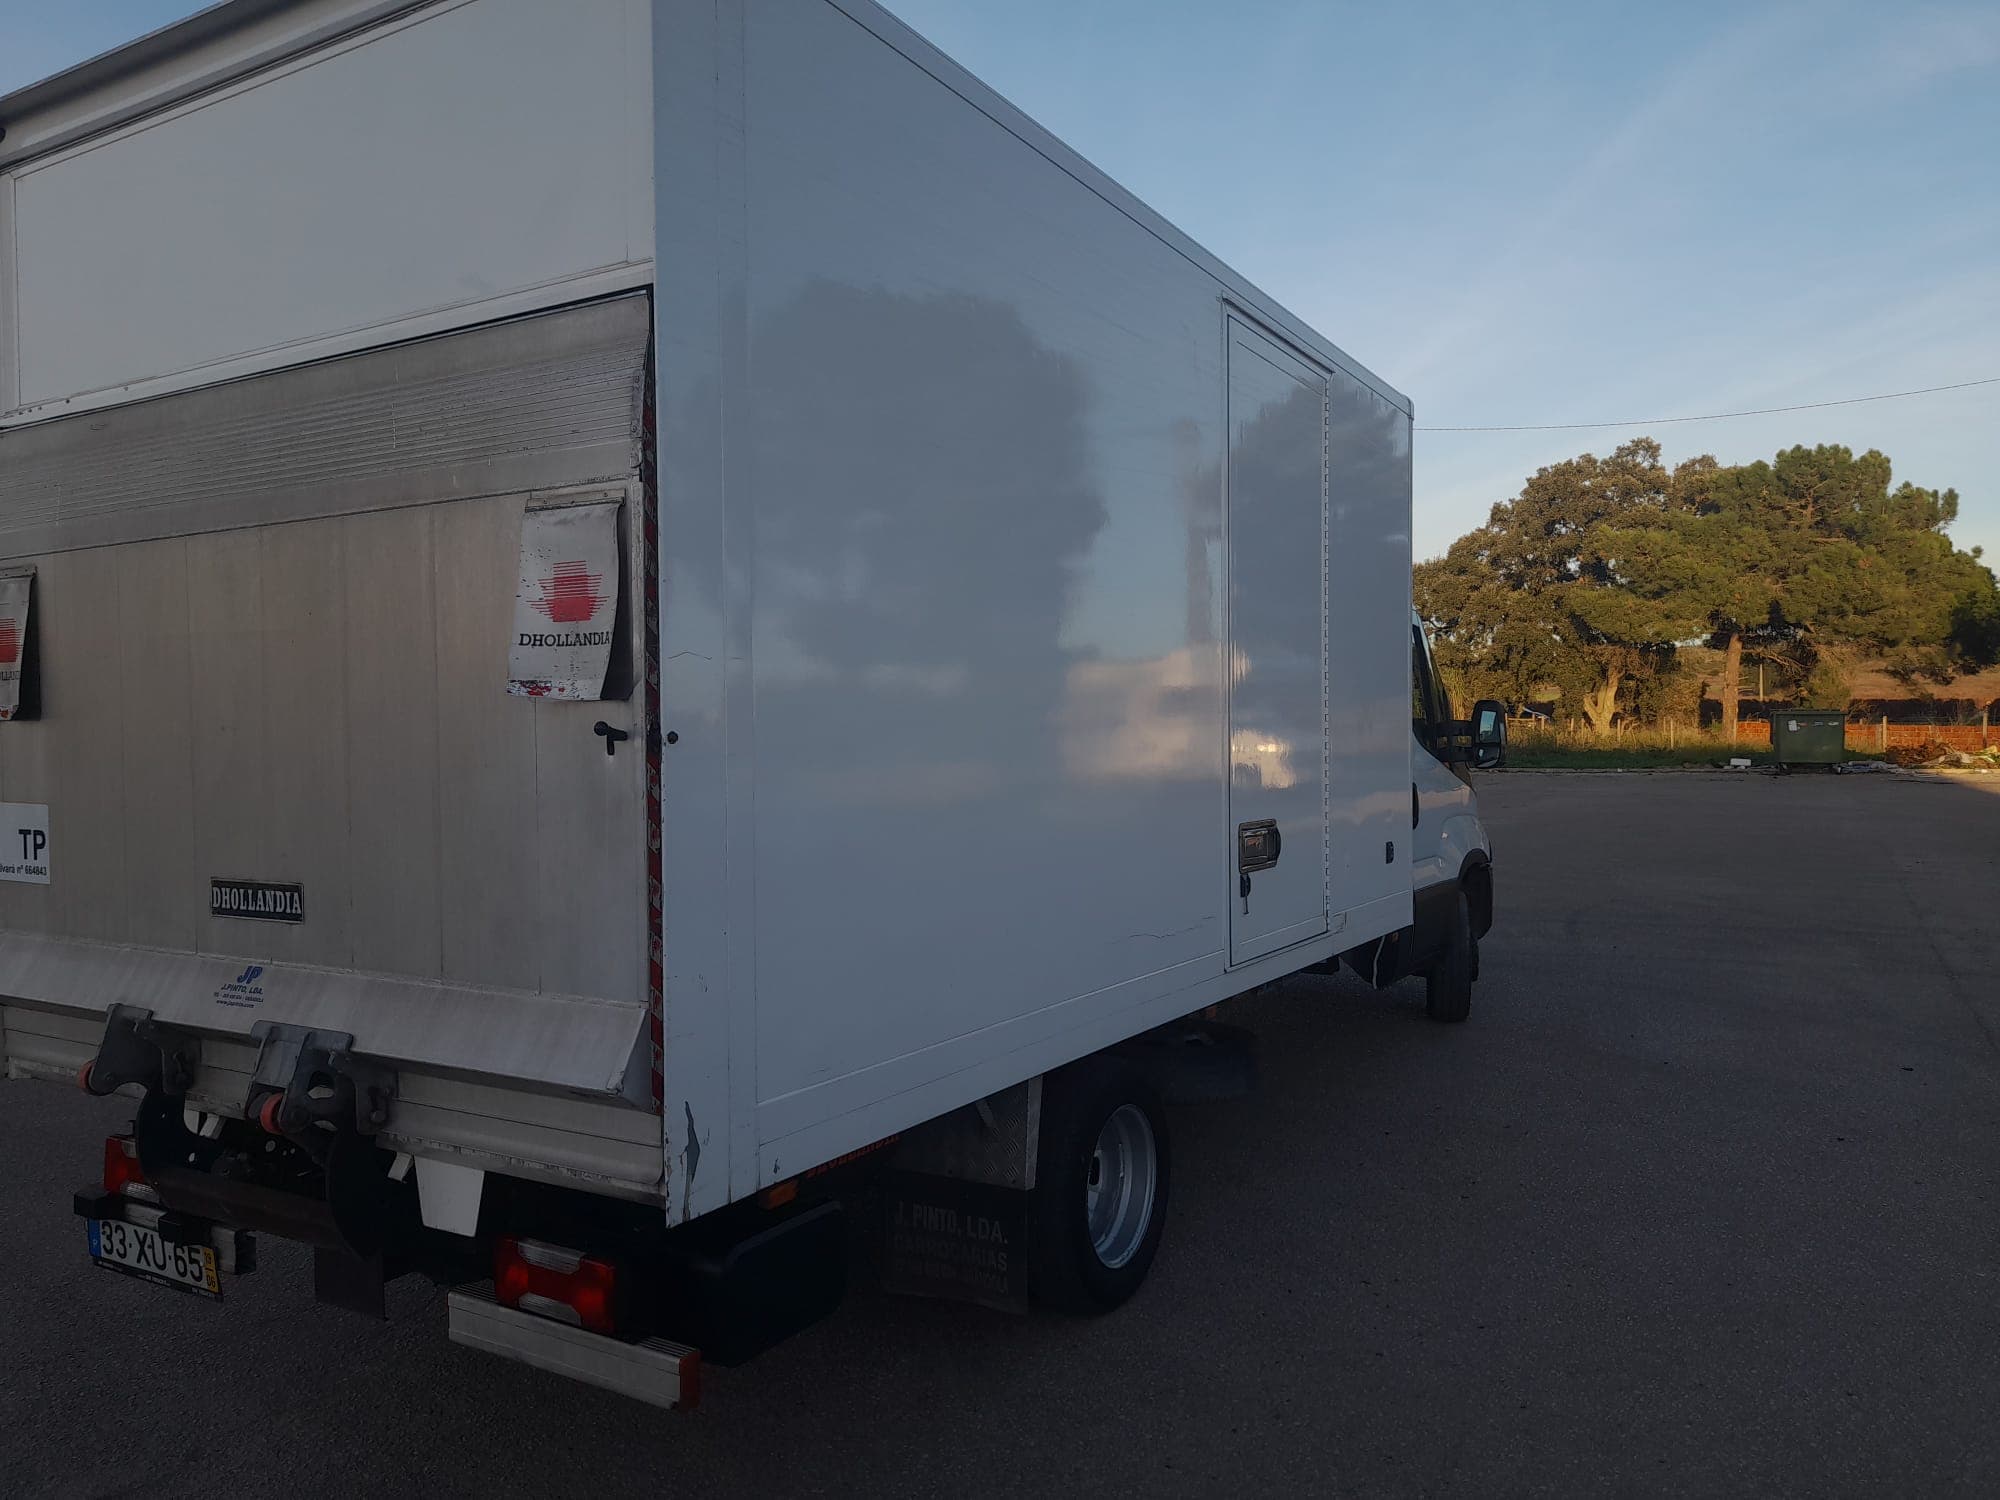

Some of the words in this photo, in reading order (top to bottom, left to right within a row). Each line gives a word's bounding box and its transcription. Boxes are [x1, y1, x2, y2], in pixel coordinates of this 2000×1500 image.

[518, 631, 610, 647] DHOLLANDIA
[18, 829, 46, 860] TP
[212, 887, 302, 915] DHOLLANDIA
[236, 965, 264, 984] JP
[967, 1215, 1009, 1245] LDA.
